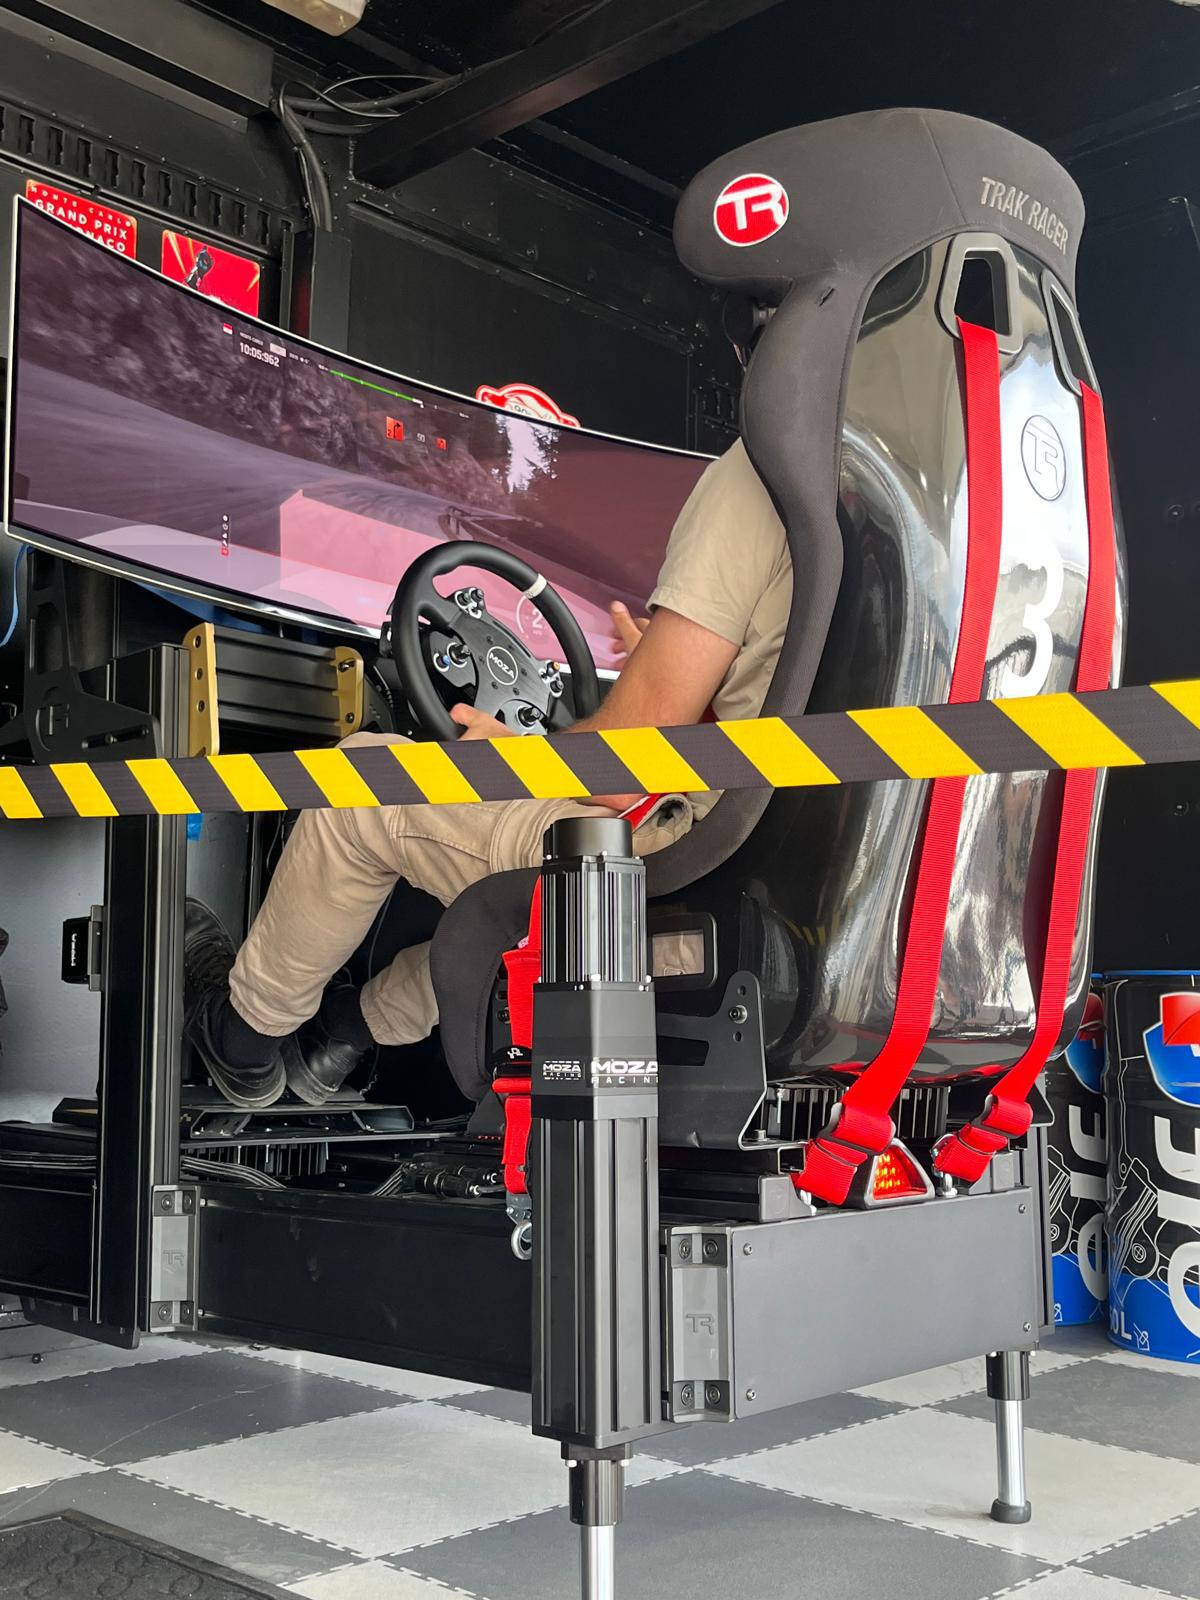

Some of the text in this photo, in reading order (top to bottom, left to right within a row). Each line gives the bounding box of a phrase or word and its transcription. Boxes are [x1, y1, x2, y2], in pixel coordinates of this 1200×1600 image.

[35, 199, 128, 240] GRAND PRIX
[981, 176, 1069, 255] TRAK RACER
[75, 227, 126, 252] NACO
[1000, 546, 1064, 699] 3
[489, 652, 515, 679] MOZA
[542, 1063, 582, 1073] MOZA
[591, 1060, 659, 1074] MOZA
[686, 1313, 715, 1336] TR
